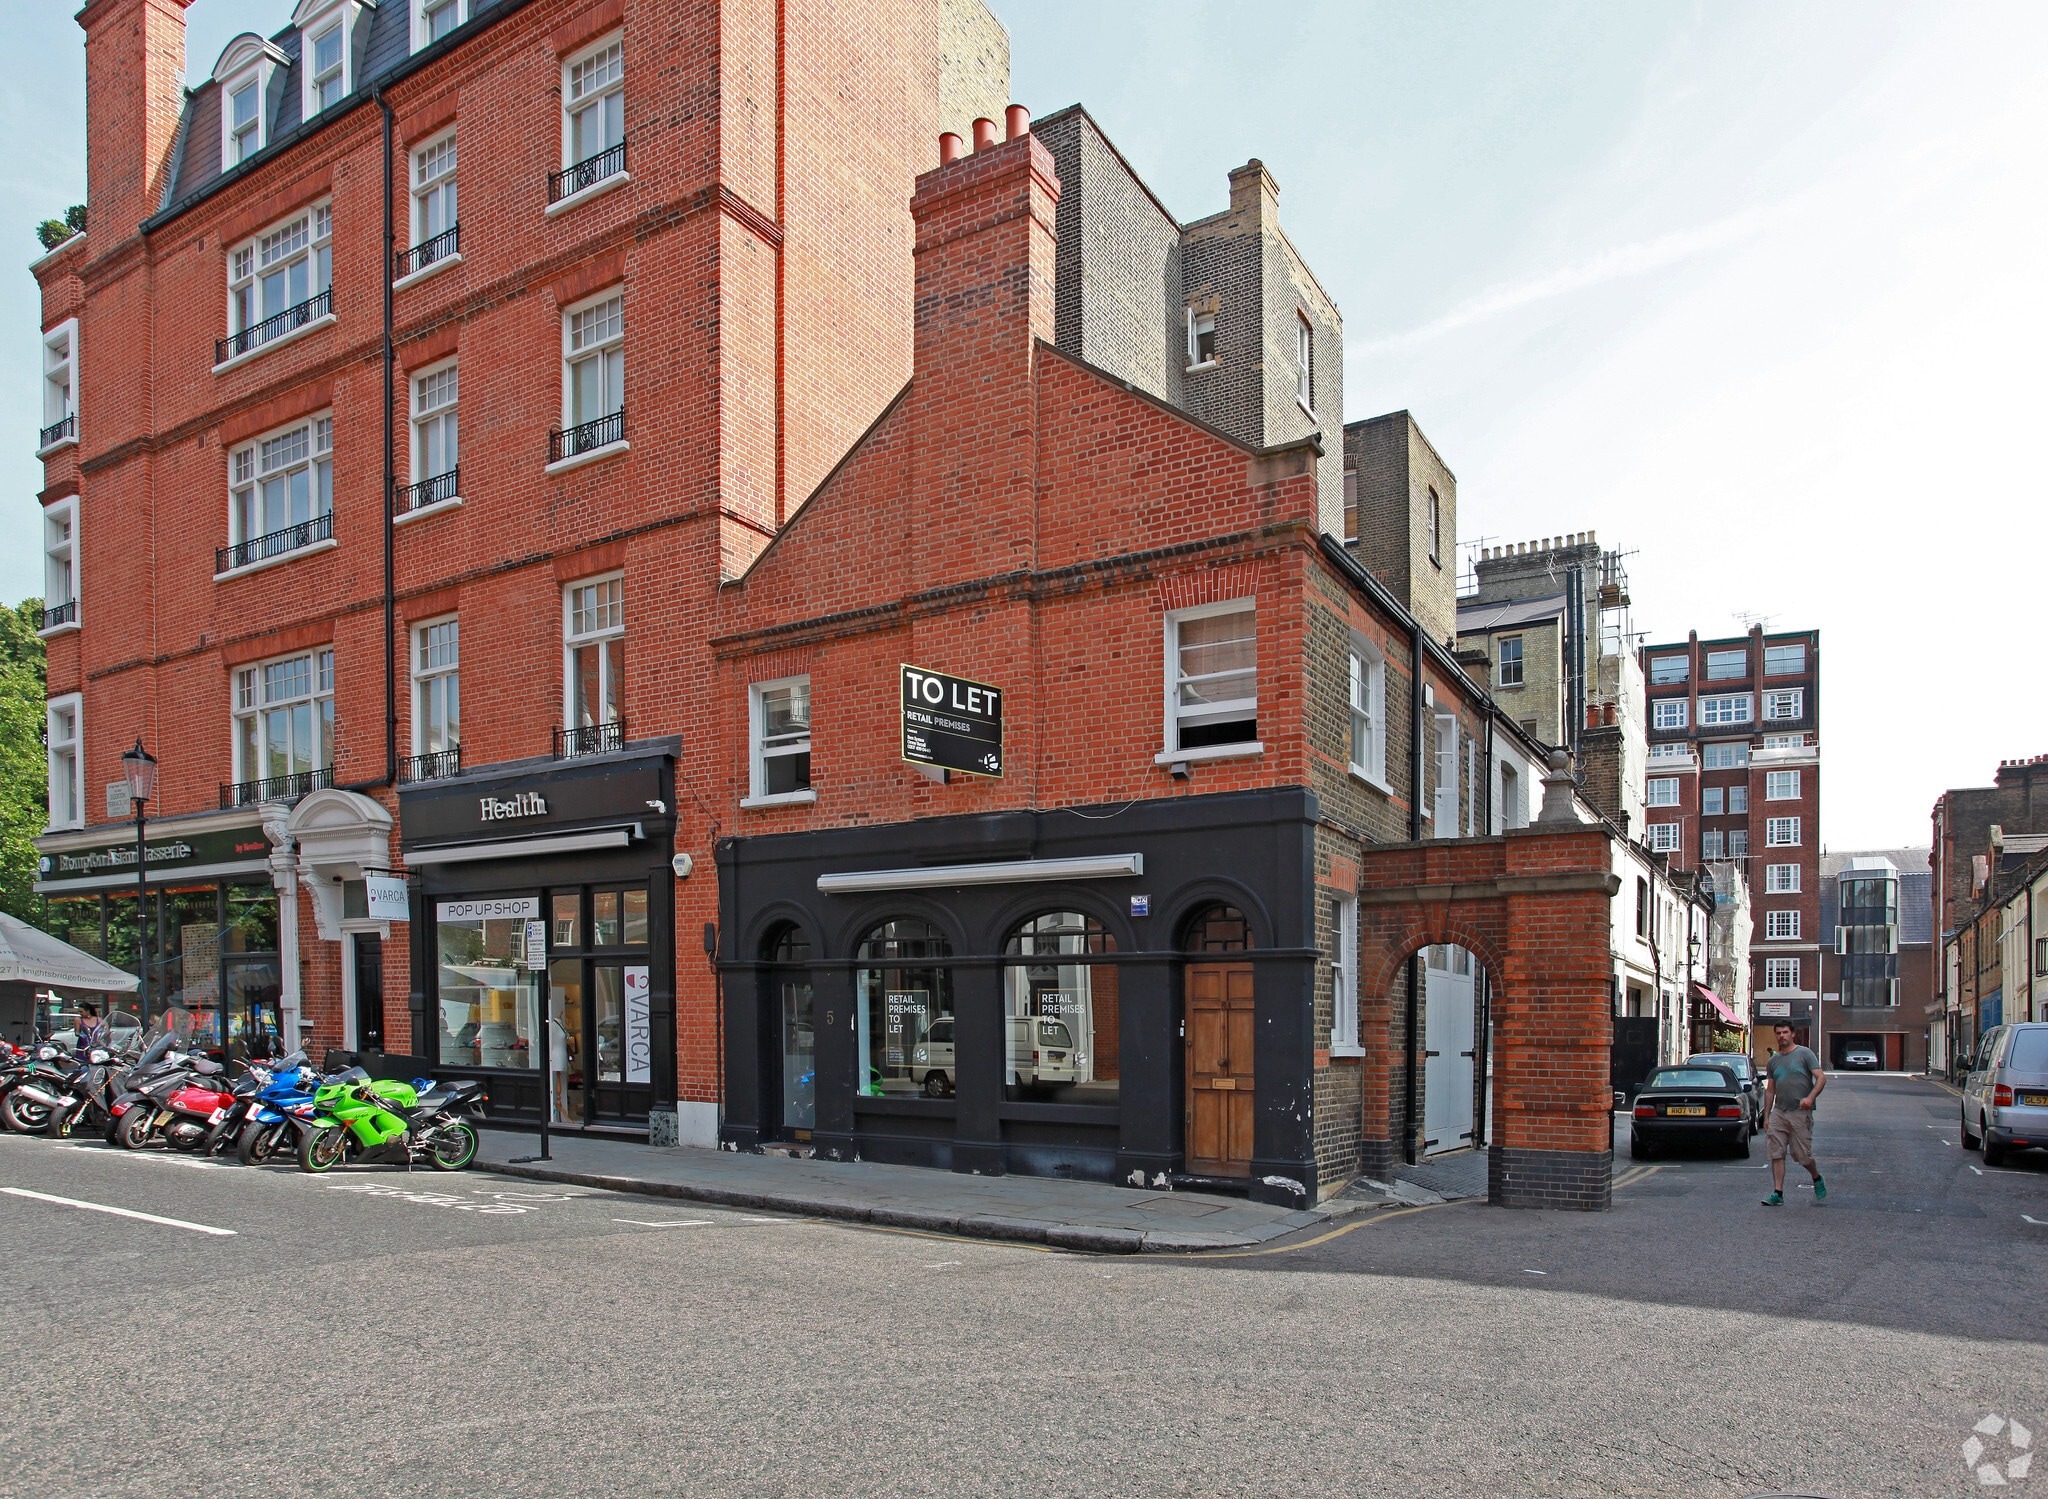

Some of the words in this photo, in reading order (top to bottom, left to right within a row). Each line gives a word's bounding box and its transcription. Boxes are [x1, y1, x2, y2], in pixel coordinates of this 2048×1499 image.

[906, 672, 944, 704] TO
[952, 683, 998, 716] LET
[907, 710, 933, 725] RETAIL
[934, 717, 971, 732] PREMISES
[480, 791, 548, 821] Health
[59, 852, 107, 874] Brompton
[136, 841, 191, 862] rasserie
[377, 889, 405, 902] VARCA
[448, 904, 473, 917] POP
[475, 903, 493, 916] UP
[494, 901, 531, 915] SHOP
[22, 966, 126, 986] knightsbridgeflowers.com
[888, 994, 915, 1004] RETAIL
[1042, 994, 1073, 1003] RETAIL
[888, 1004, 927, 1014] PREMISES
[1042, 1004, 1085, 1014] PREMISES
[826, 1010, 834, 1025] 5
[888, 1014, 901, 1023] TO
[1042, 1015, 1056, 1024] TO
[630, 993, 650, 1073] VARCA
[889, 1024, 904, 1034] LET
[1042, 1026, 1059, 1035] LET
